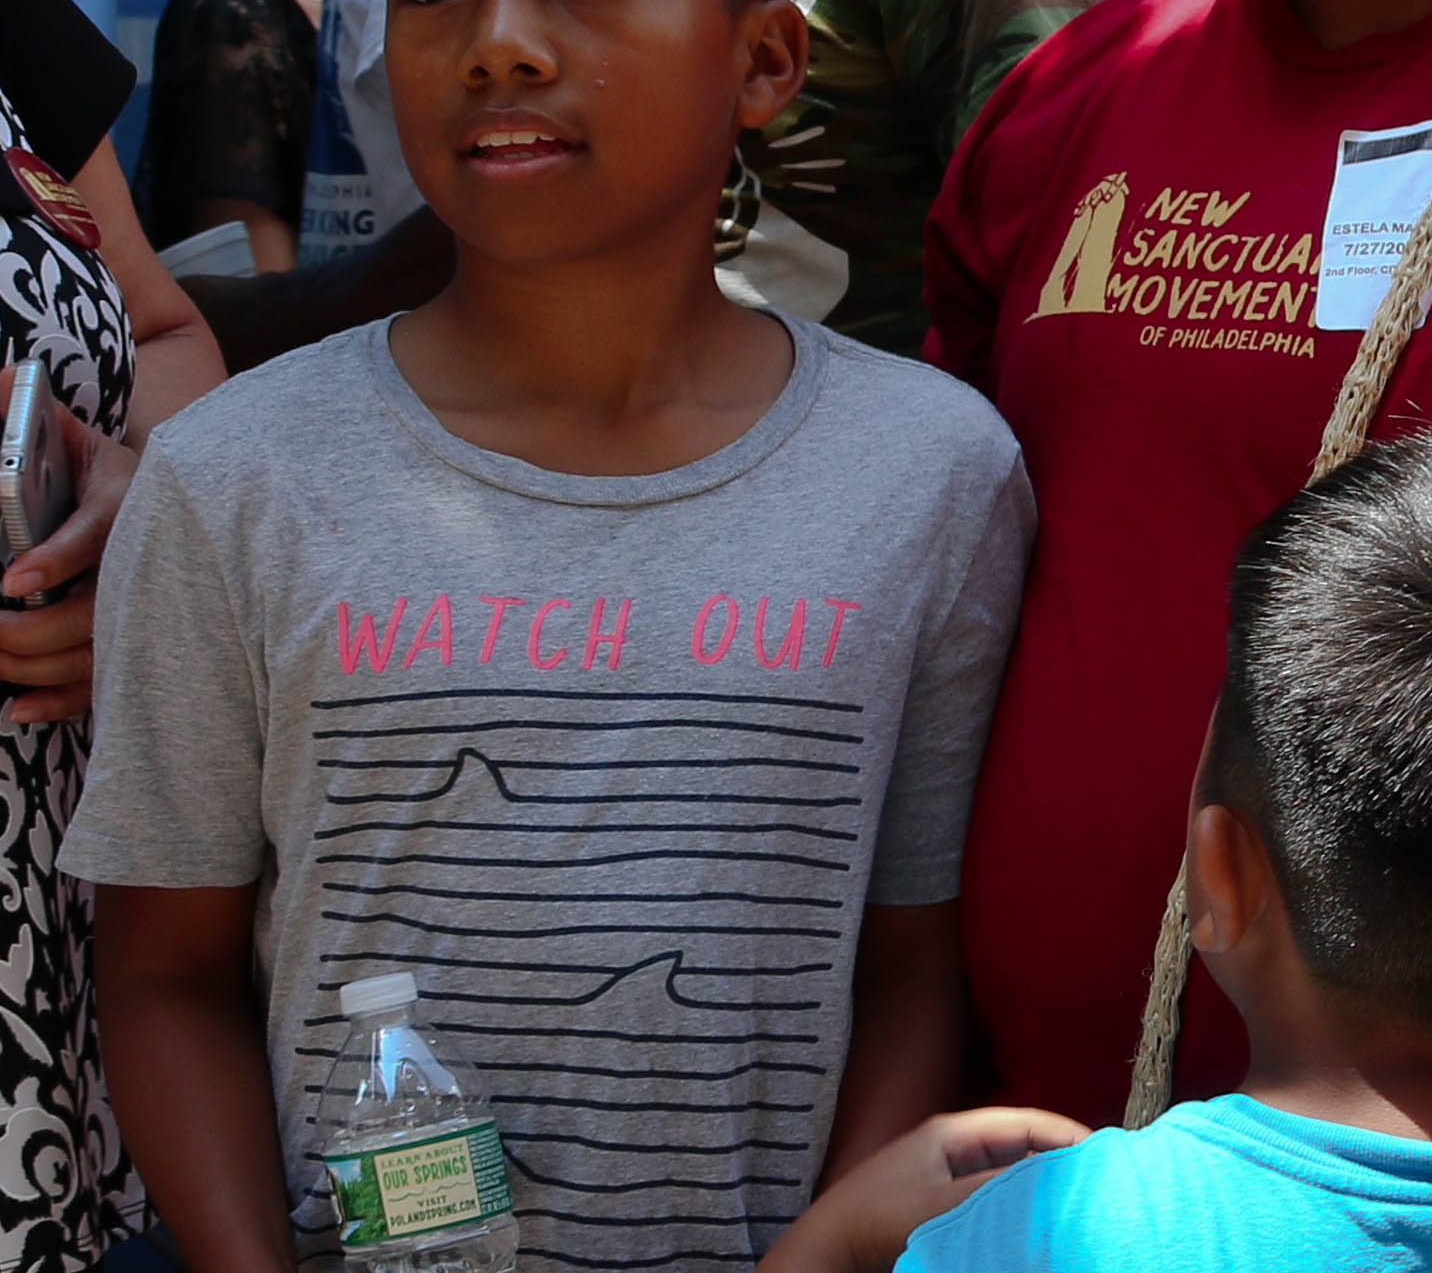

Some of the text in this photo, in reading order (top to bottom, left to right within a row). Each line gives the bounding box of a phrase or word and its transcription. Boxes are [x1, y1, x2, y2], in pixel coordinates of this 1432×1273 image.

[1144, 187, 1251, 228] NEW
[1332, 222, 1414, 235] ESTELA MA
[1123, 228, 1322, 276] SANCTUA
[1344, 241, 1406, 256] 7/27/20
[1324, 267, 1345, 277] 2nd
[1139, 325, 1315, 359] OF PHILADELPHIA
[337, 592, 861, 675] WATCH OUT
[382, 1144, 464, 1168] LEARN ABOUT
[383, 1155, 468, 1190] OUR SPRINGS
[389, 1199, 476, 1227] POLANDSPRING.COM
[417, 1194, 447, 1207] VISIT
